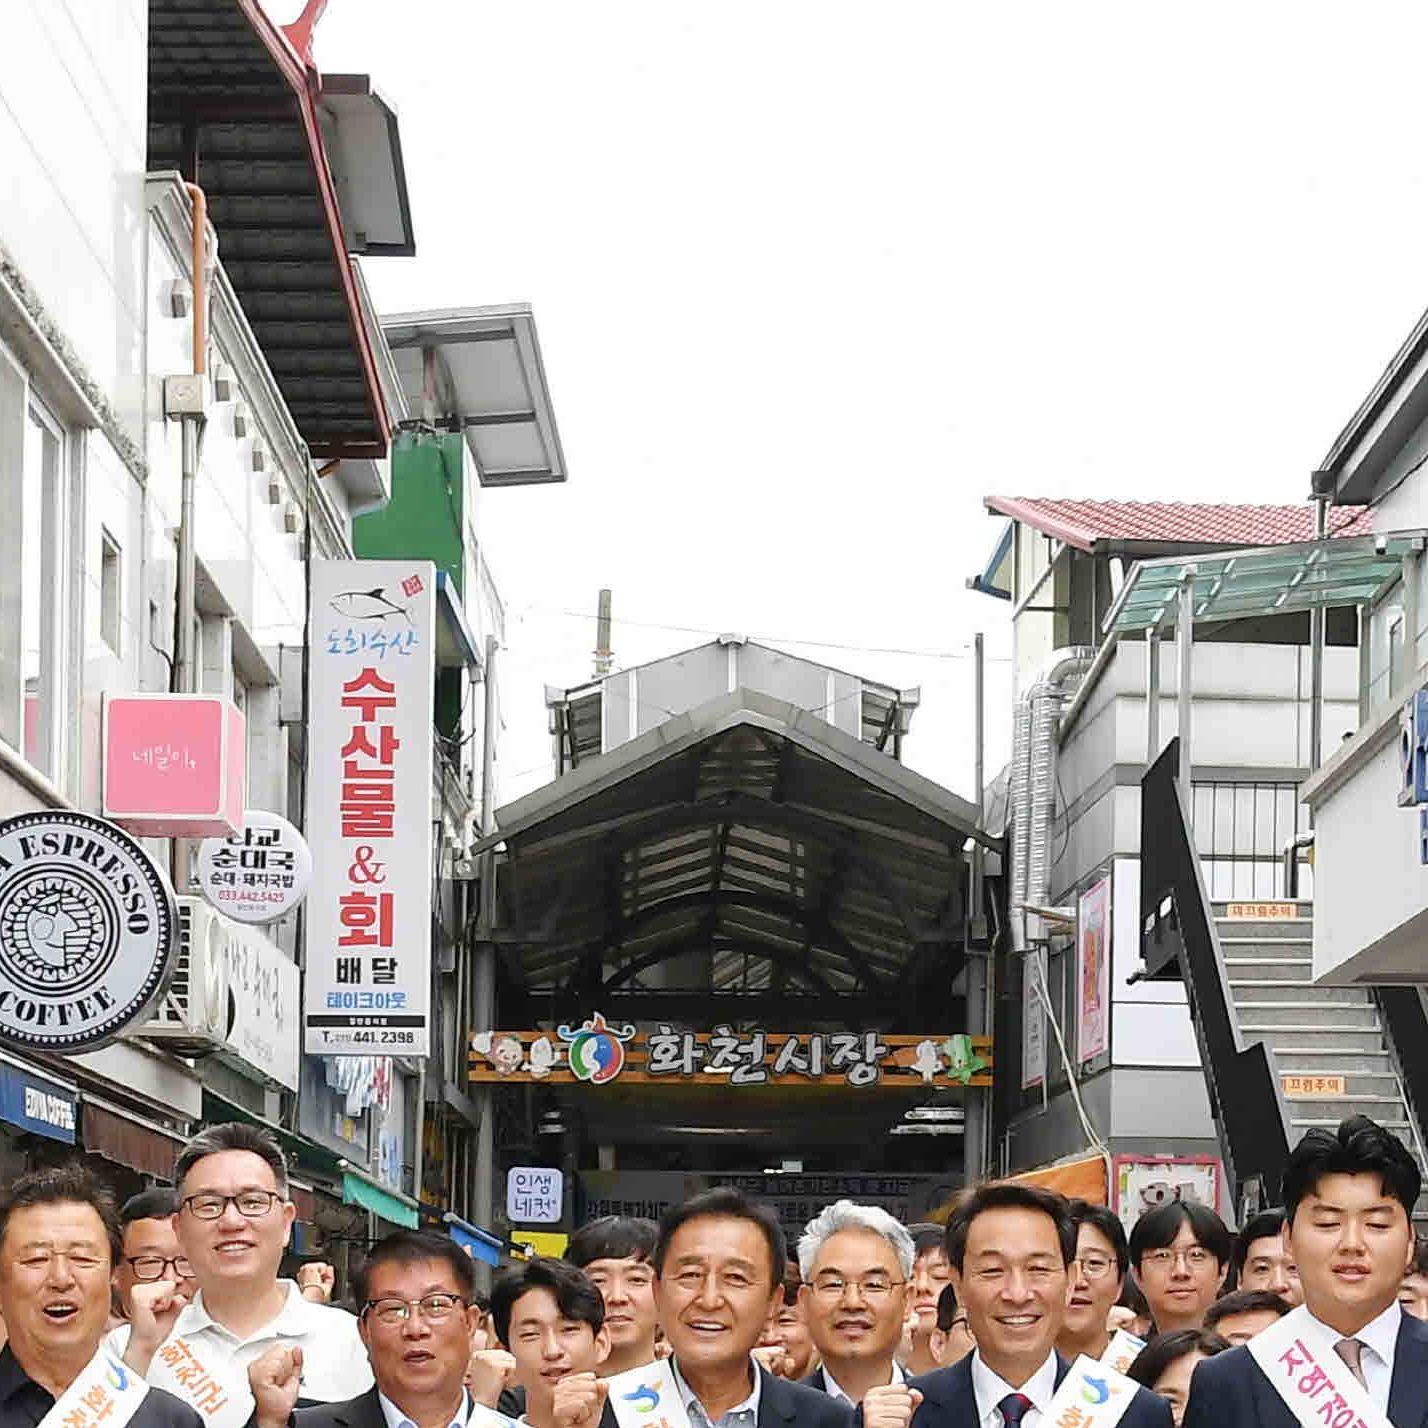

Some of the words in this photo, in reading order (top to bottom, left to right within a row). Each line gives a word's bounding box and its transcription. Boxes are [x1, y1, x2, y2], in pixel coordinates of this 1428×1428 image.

[341, 667, 400, 838] 수산물
[17, 832, 150, 936] ESPRESSO
[212, 848, 295, 870] 순대국
[348, 845, 387, 885] &
[338, 891, 395, 948] 회
[326, 991, 407, 1010] 테이크아웃
[646, 1024, 889, 1086] 화천시장
[516, 1174, 552, 1194] 인생
[159, 1339, 229, 1415] 화천군
